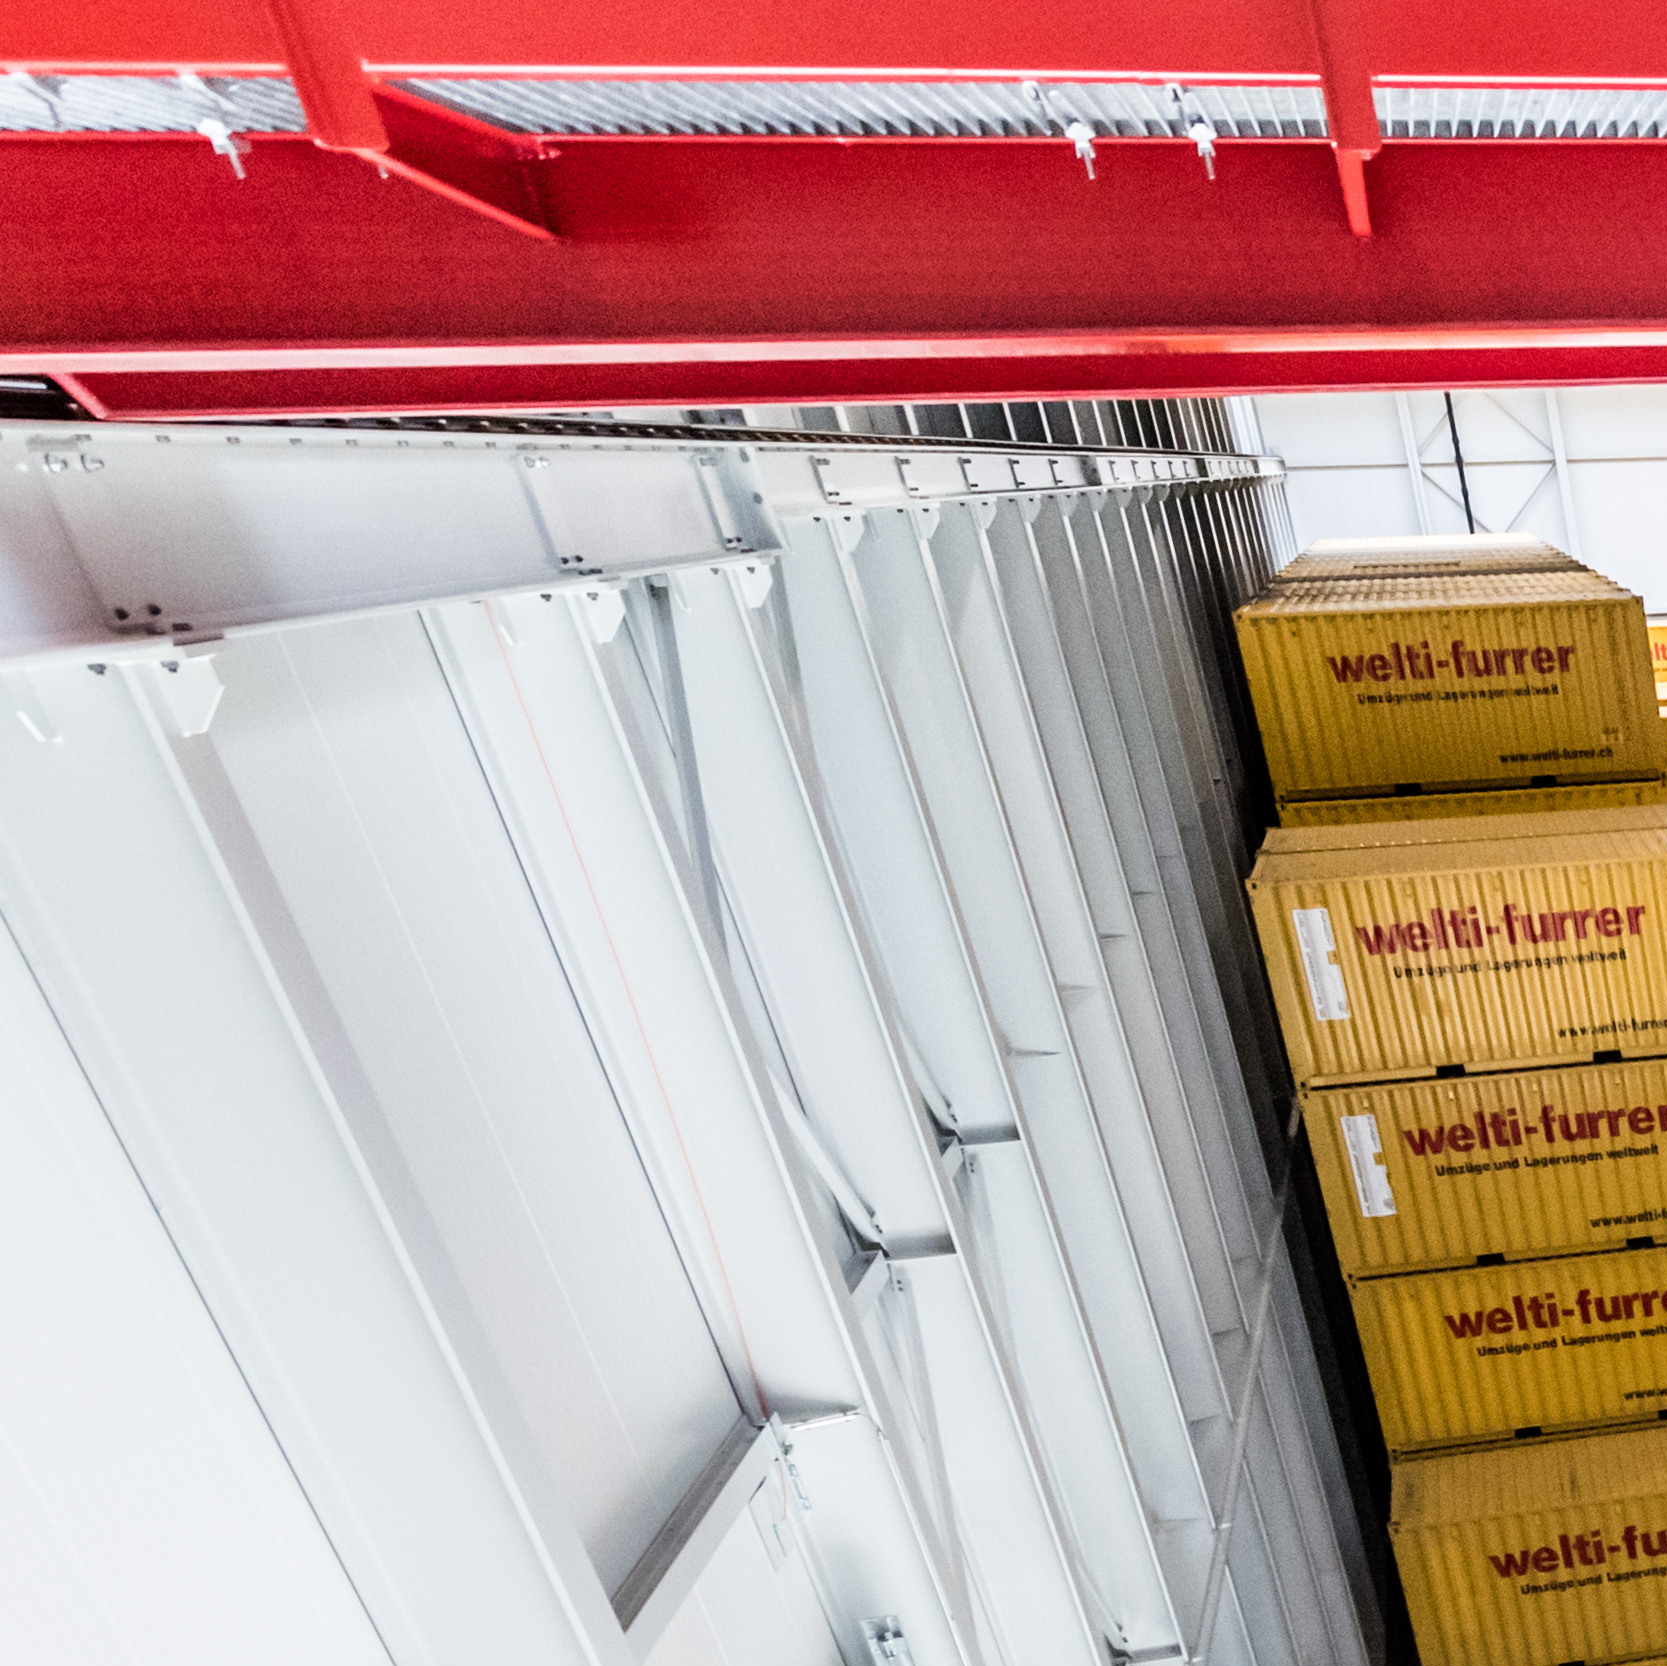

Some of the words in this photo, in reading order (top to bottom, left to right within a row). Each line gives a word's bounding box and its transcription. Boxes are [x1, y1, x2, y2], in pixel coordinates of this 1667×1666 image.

[1327, 640, 1575, 683] welti-furrer
[1356, 903, 1645, 955] welti-furrer
[1435, 1161, 1491, 1177] Umzüge
[1494, 1157, 1520, 1171] und
[1524, 1151, 1603, 1169] Lagerungen
[1605, 1143, 1659, 1160] weltweit
[1477, 1342, 1531, 1357] Umzüge
[1533, 1338, 1558, 1351] und
[1561, 1330, 1636, 1348] Lagerungen
[1521, 1579, 1575, 1595] Umzüge
[1577, 1574, 1603, 1588] und
